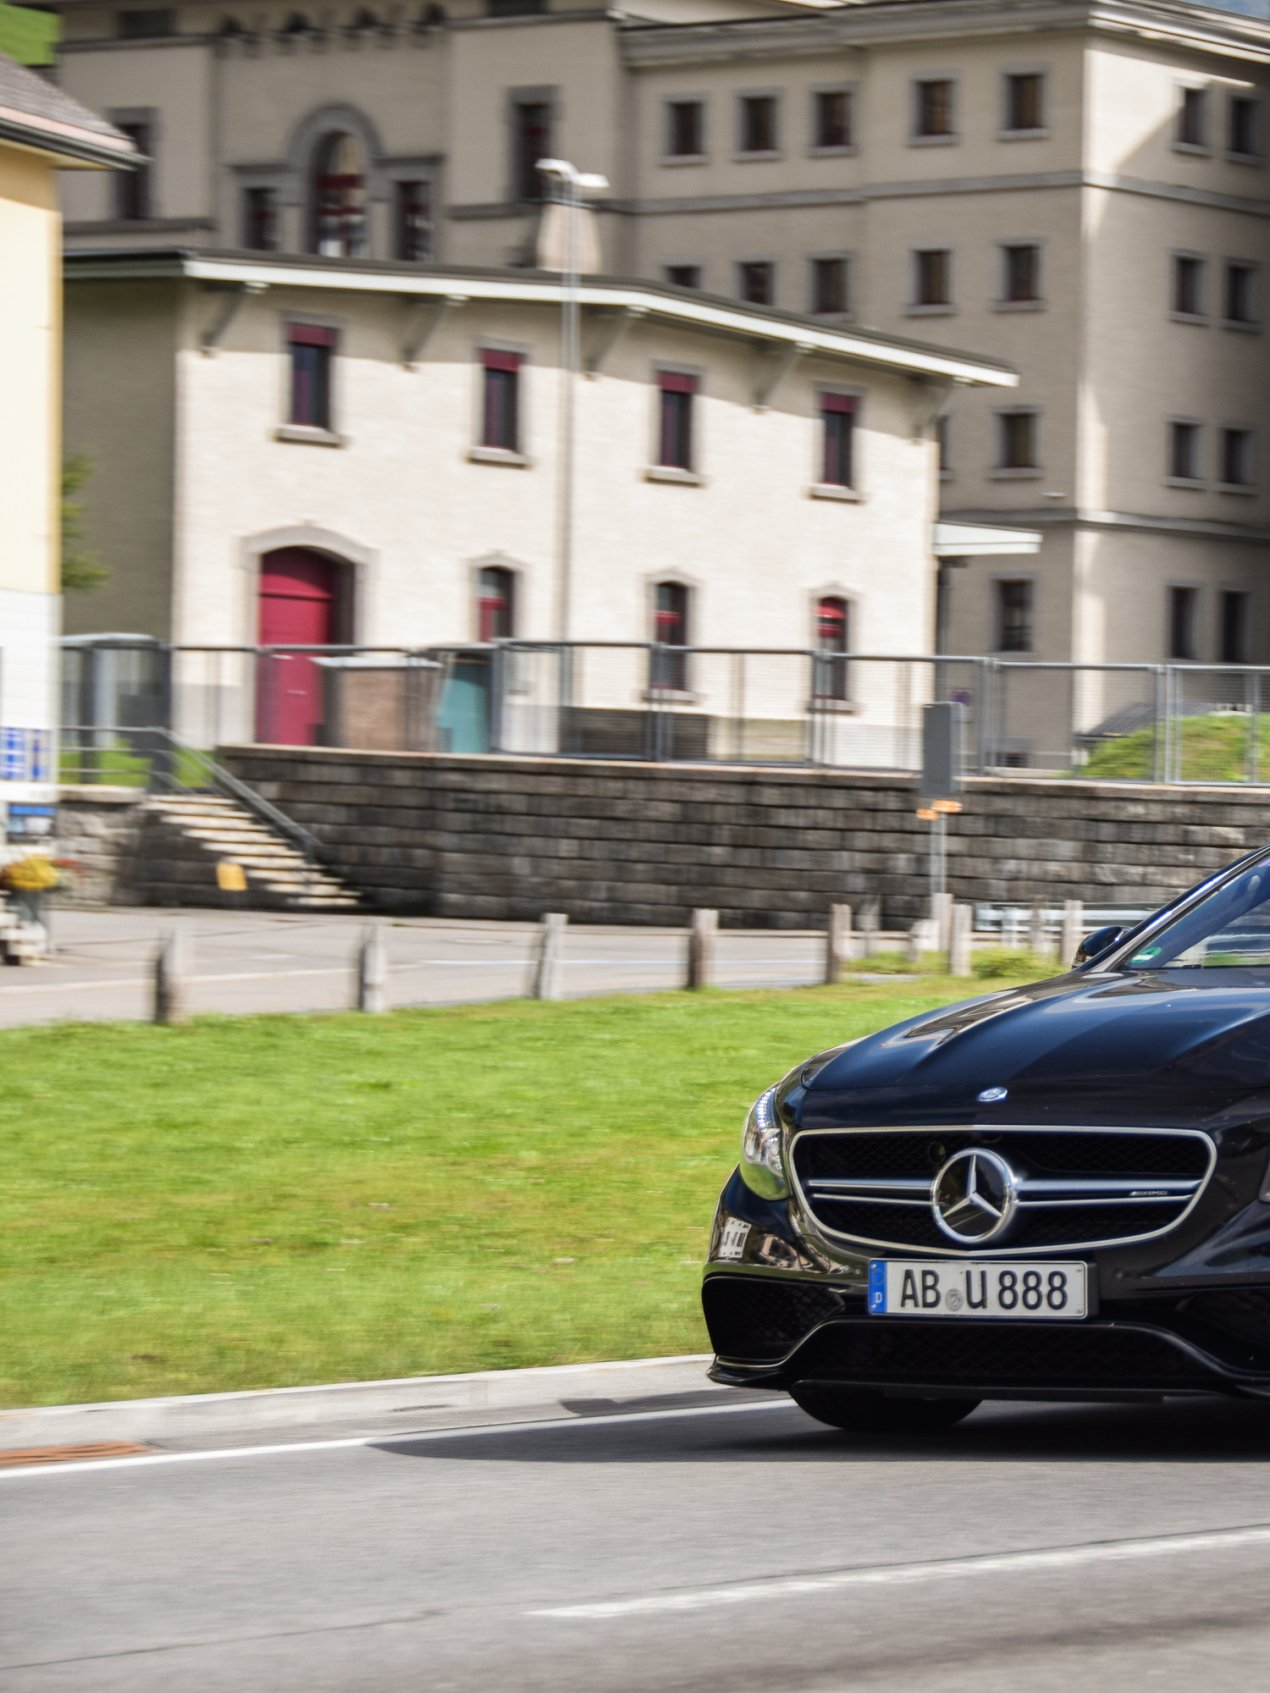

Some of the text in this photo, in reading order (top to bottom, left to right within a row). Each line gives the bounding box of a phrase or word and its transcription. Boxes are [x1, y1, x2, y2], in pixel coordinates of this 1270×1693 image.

[875, 1292, 883, 1303] D
[900, 1269, 1068, 1310] AB U 888
